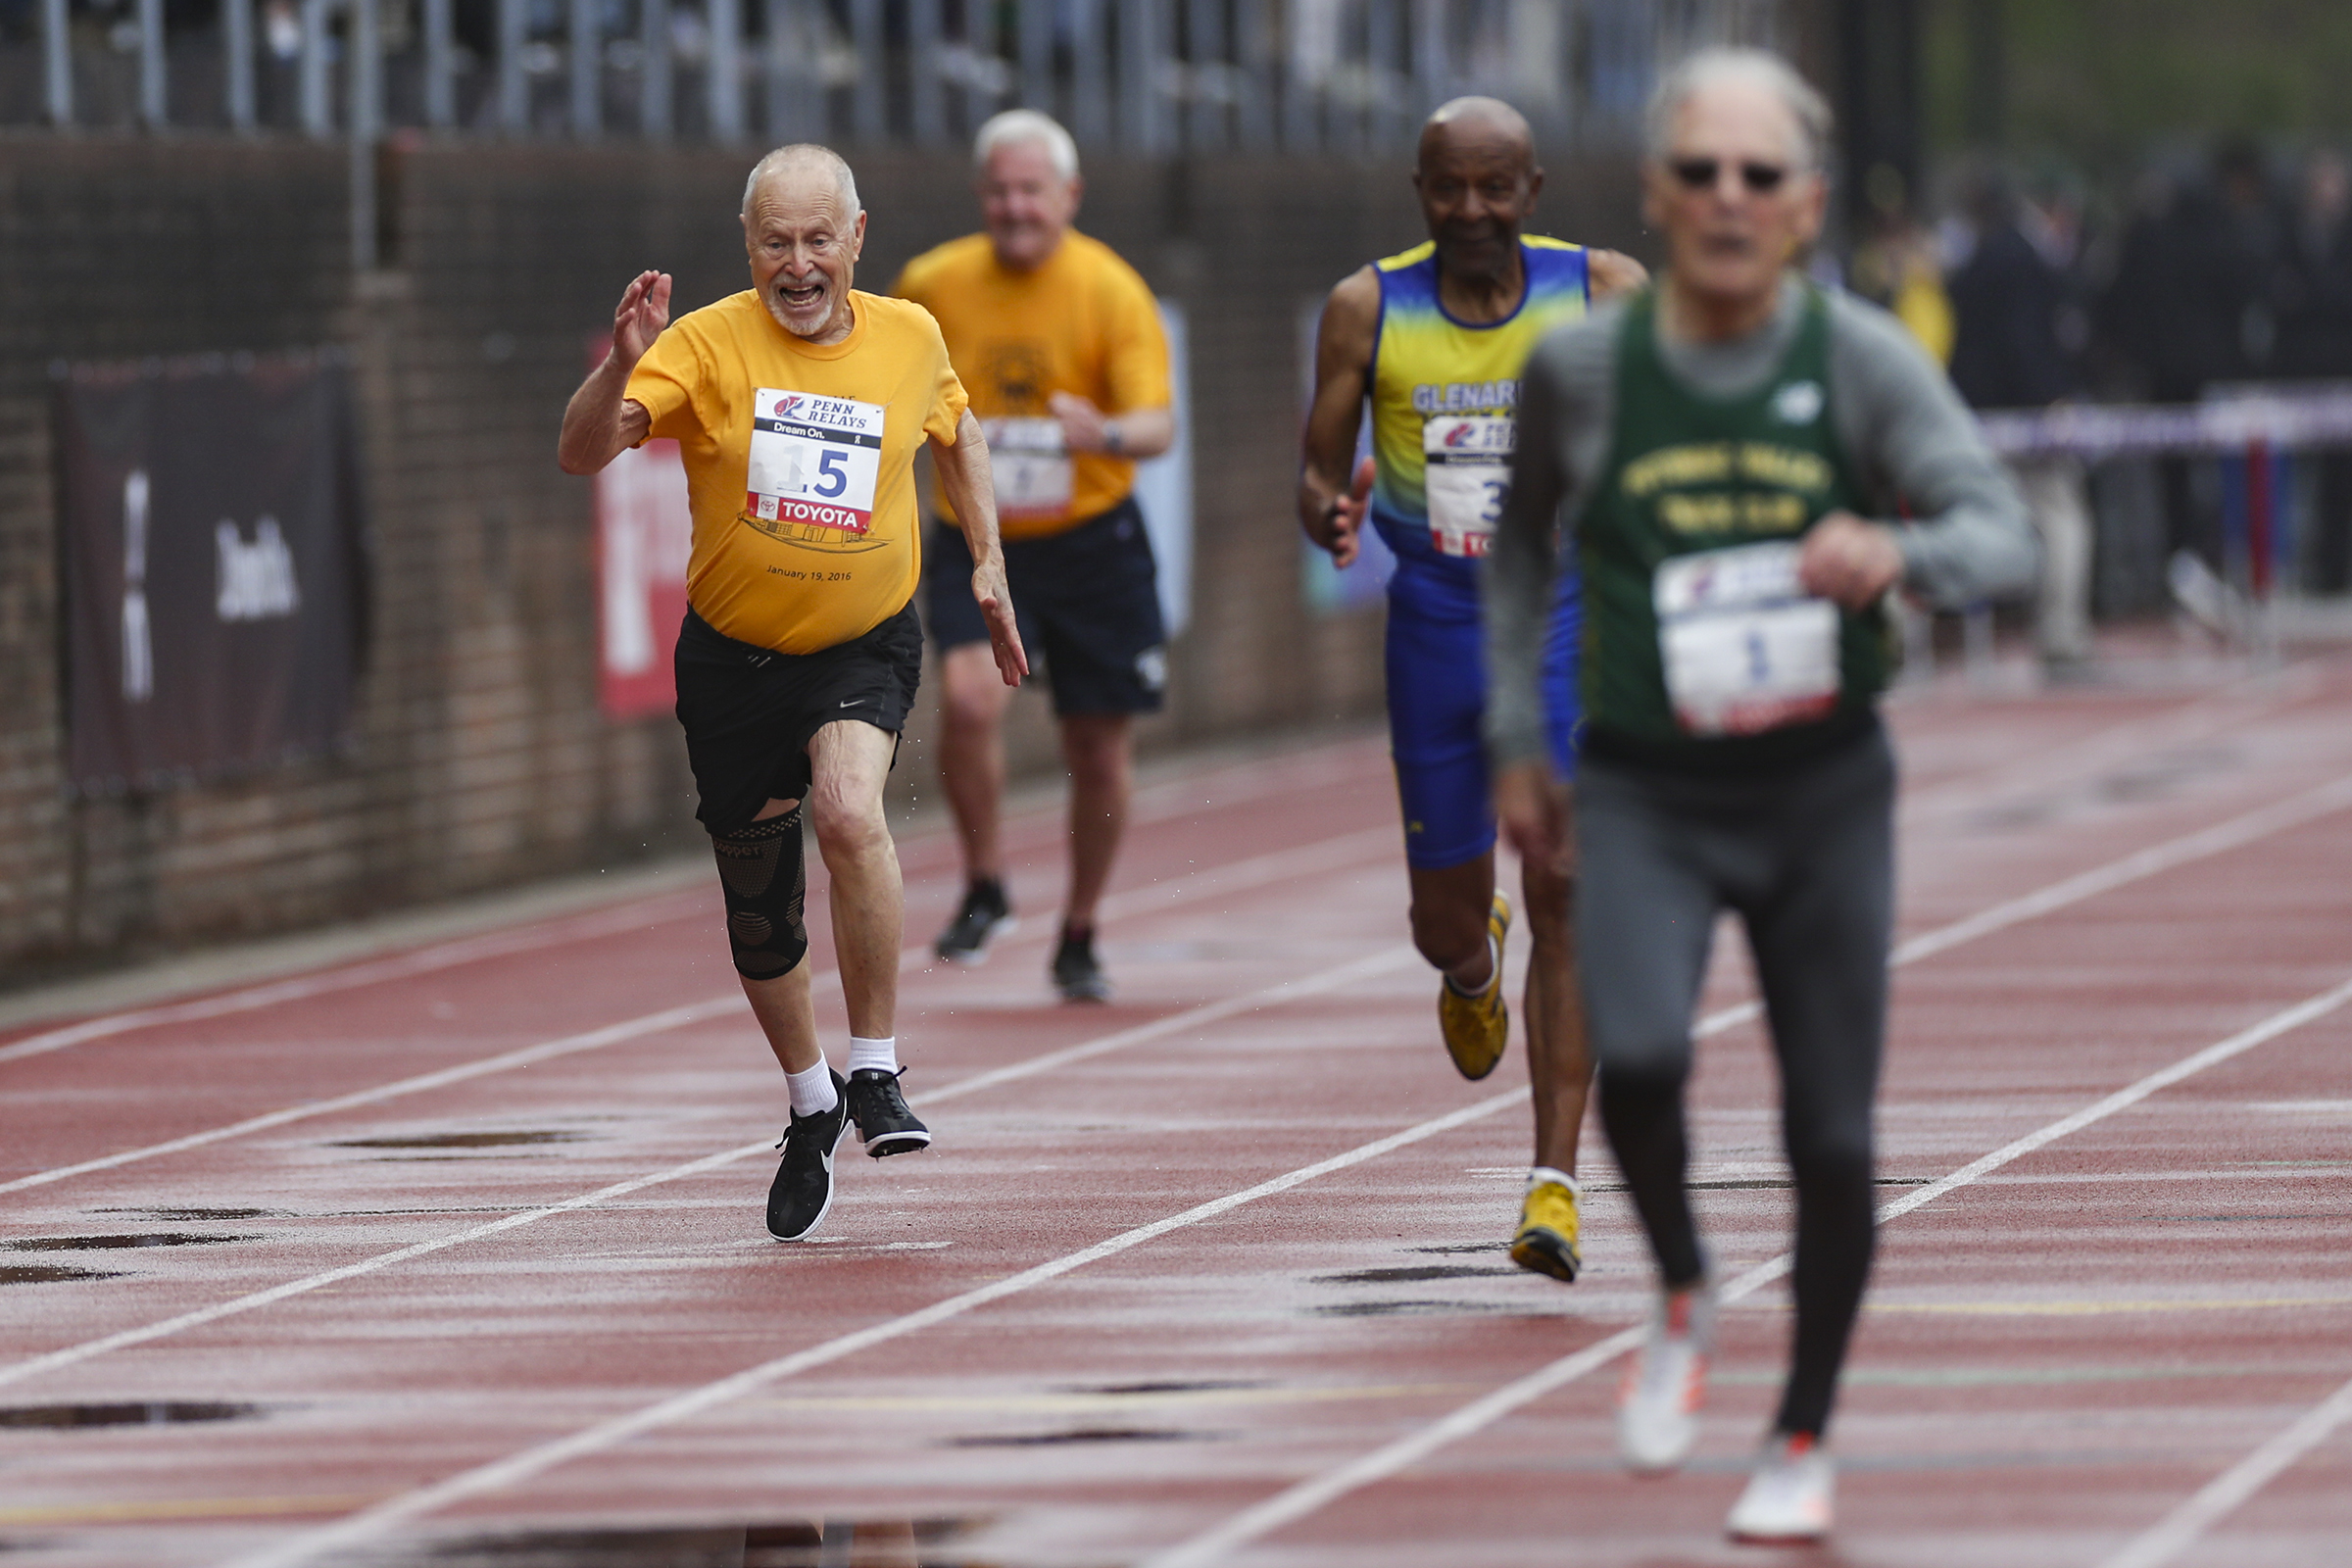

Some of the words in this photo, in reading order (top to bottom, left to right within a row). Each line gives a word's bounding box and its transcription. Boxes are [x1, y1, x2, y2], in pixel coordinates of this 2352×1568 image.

[1412, 378, 1523, 412] GLENAR
[811, 399, 856, 415] PENN
[808, 411, 866, 429] RELAYS
[773, 422, 807, 436] Dream
[807, 428, 825, 439] On.
[782, 501, 858, 528] TOYOTA
[766, 564, 808, 581] January
[810, 572, 825, 582] 19,
[827, 571, 852, 582] 2016
